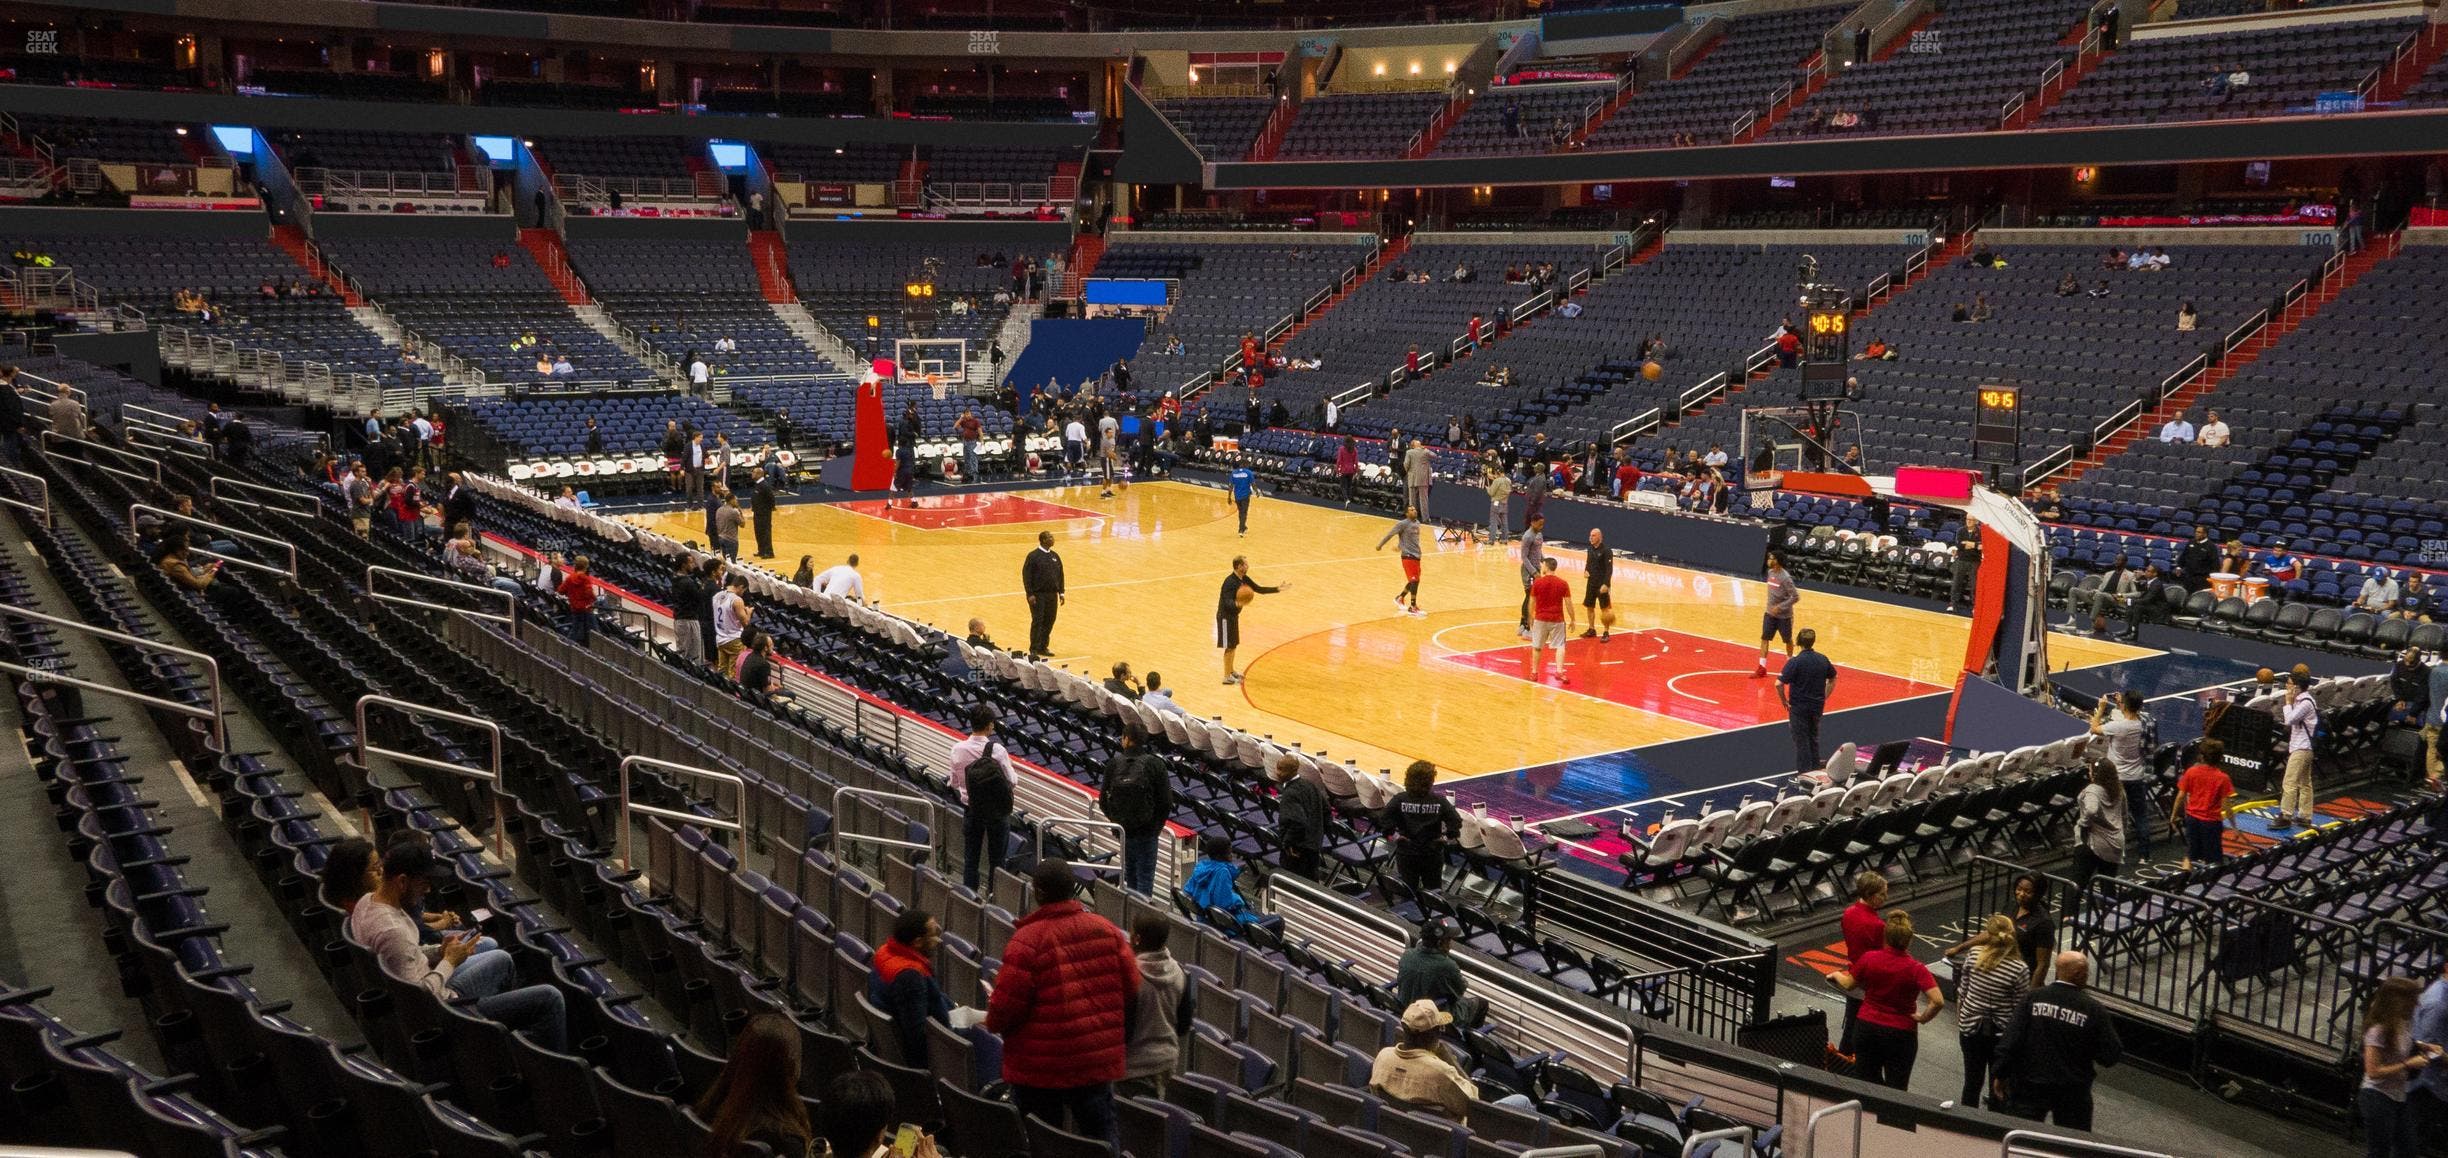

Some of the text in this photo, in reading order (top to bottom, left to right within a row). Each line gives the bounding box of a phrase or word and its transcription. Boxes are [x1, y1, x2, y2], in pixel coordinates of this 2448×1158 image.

[1360, 236, 1376, 246] 103
[1906, 234, 1924, 244] 101
[2304, 233, 2333, 246] 100
[907, 284, 933, 296] 40:15
[1812, 314, 1845, 333] 40:15
[1982, 391, 2014, 408] 40:15
[717, 606, 724, 623] 2
[2222, 754, 2263, 771] TISSOT
[1400, 802, 1441, 815] EVENT STAFF
[2032, 1002, 2089, 1028] EVENT STAFF
